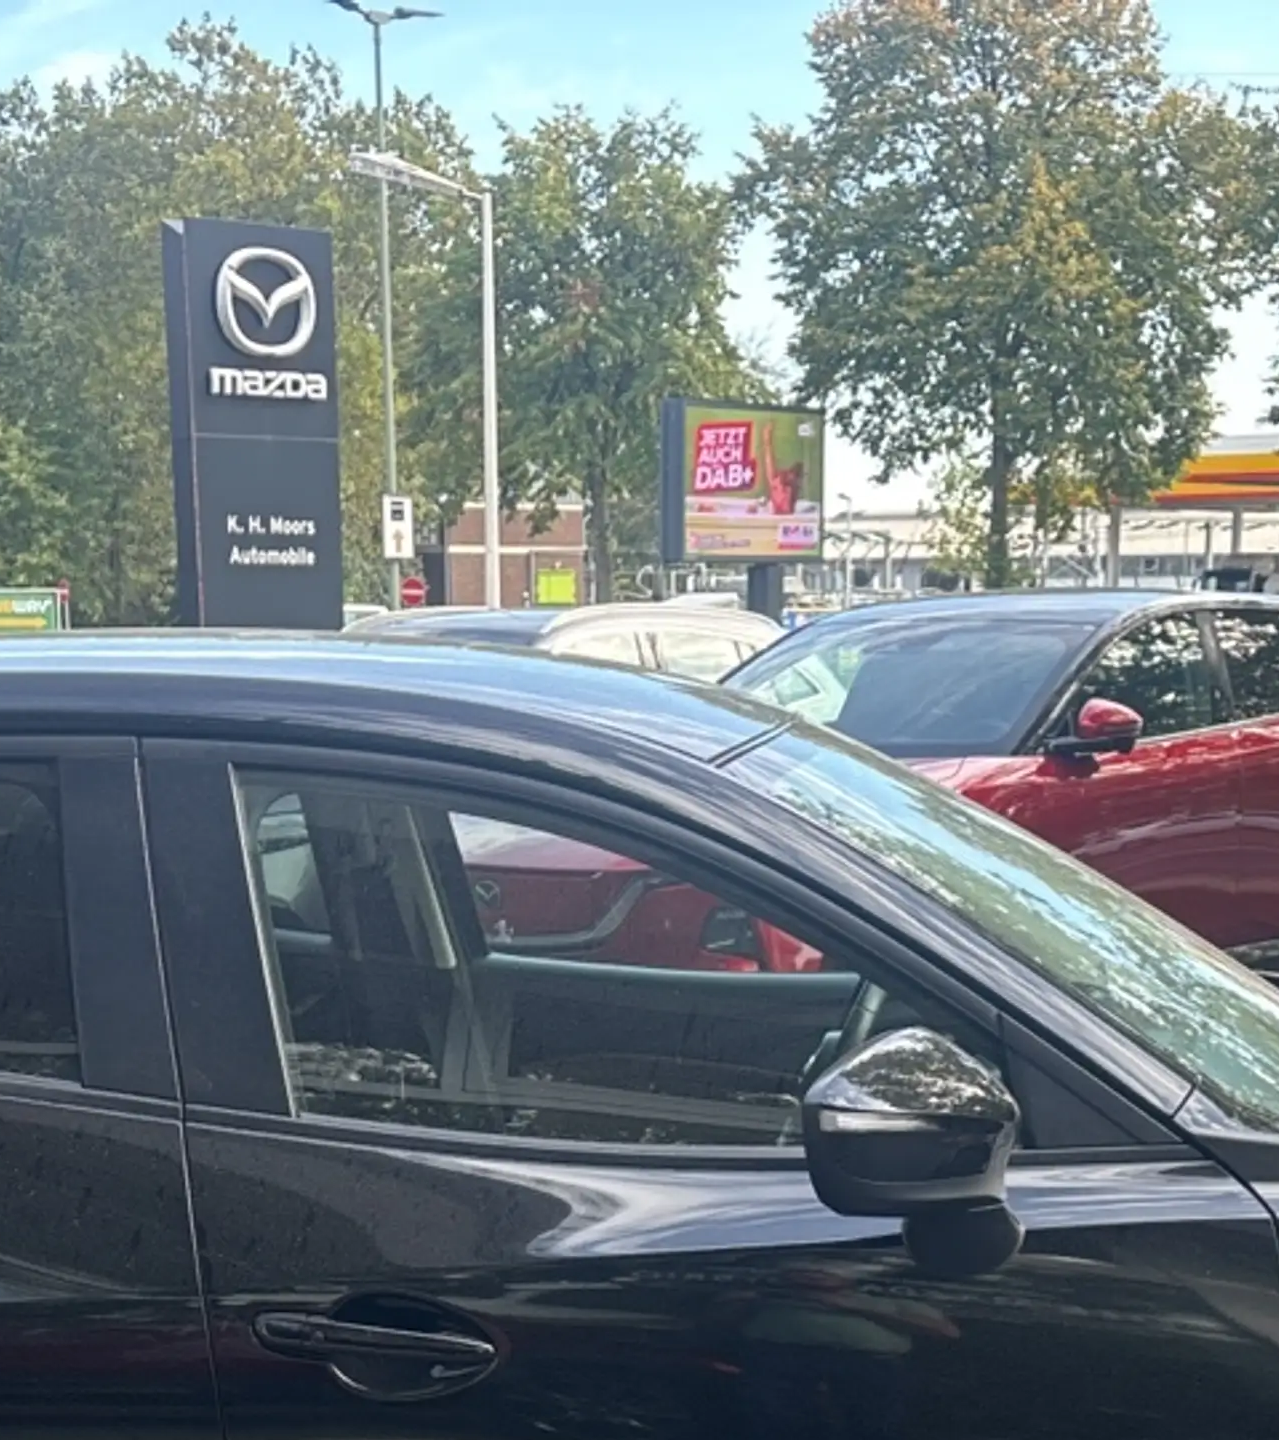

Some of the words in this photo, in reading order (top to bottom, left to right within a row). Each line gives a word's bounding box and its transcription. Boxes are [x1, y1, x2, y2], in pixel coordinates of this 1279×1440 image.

[700, 426, 747, 446] JETZT
[698, 446, 743, 463] AUCH
[694, 464, 754, 490] DAB+
[226, 514, 245, 534] K.
[248, 515, 266, 534] H.
[270, 516, 317, 536] Moors
[229, 545, 317, 566] Automobile
